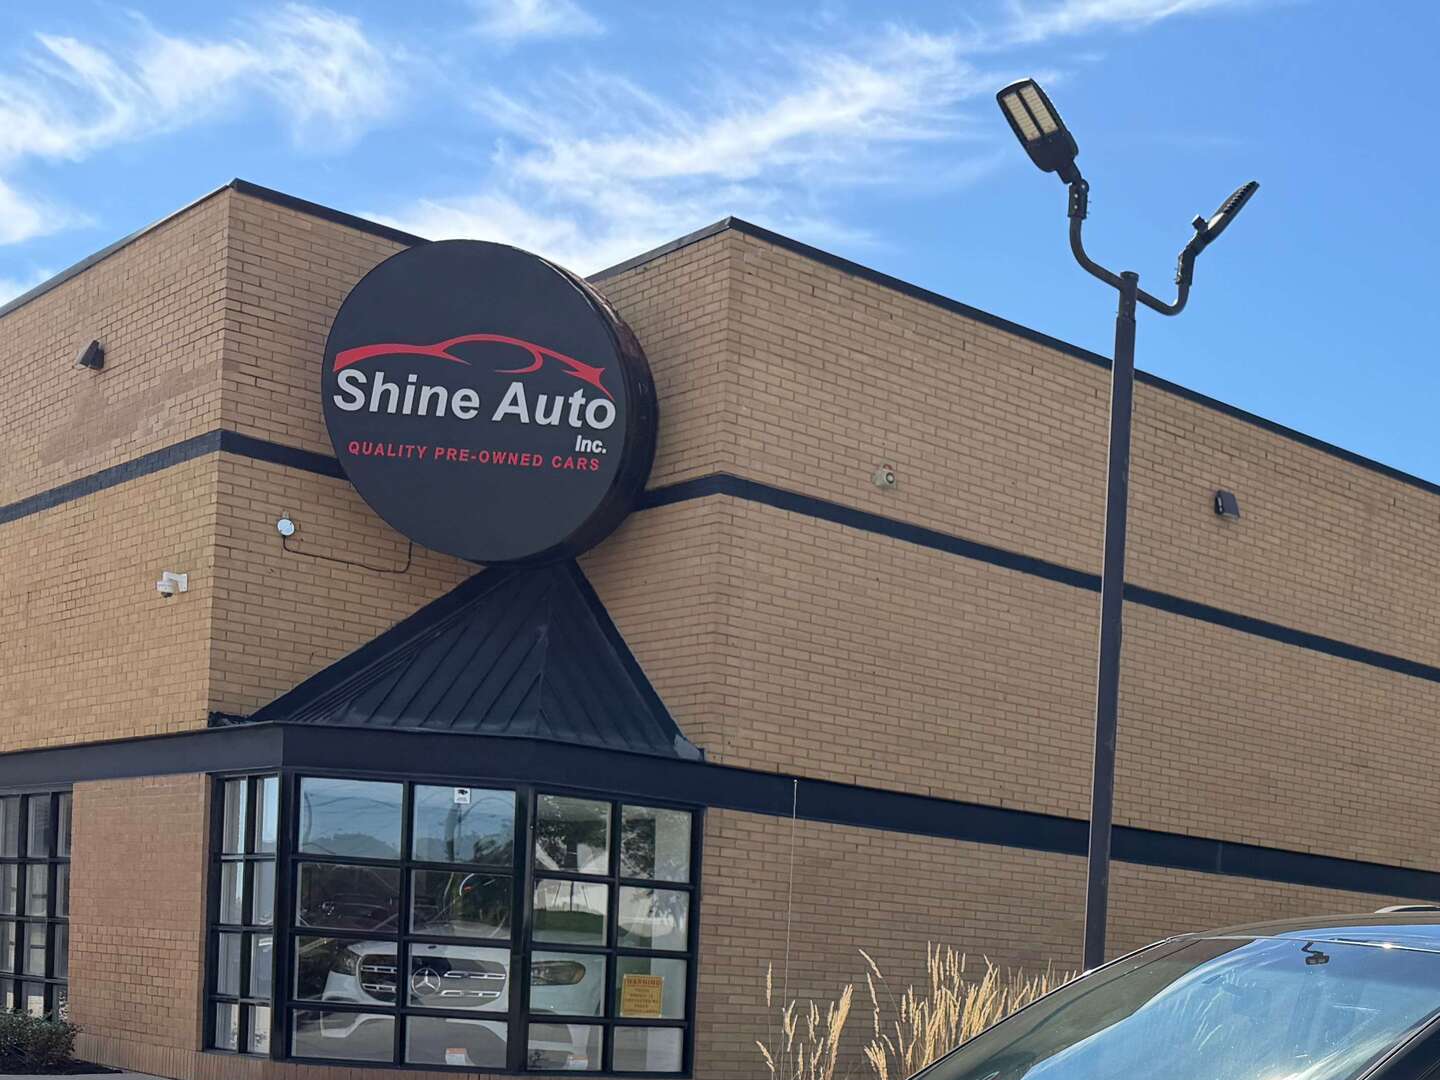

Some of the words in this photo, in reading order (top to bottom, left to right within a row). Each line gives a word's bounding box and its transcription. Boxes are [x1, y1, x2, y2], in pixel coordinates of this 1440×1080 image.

[333, 369, 480, 420] Shine
[492, 381, 616, 430] Auto
[348, 441, 428, 460] QUALITY
[434, 446, 544, 468] PRE-OWNED
[551, 455, 600, 471] CARS
[575, 435, 607, 454] Inc.
